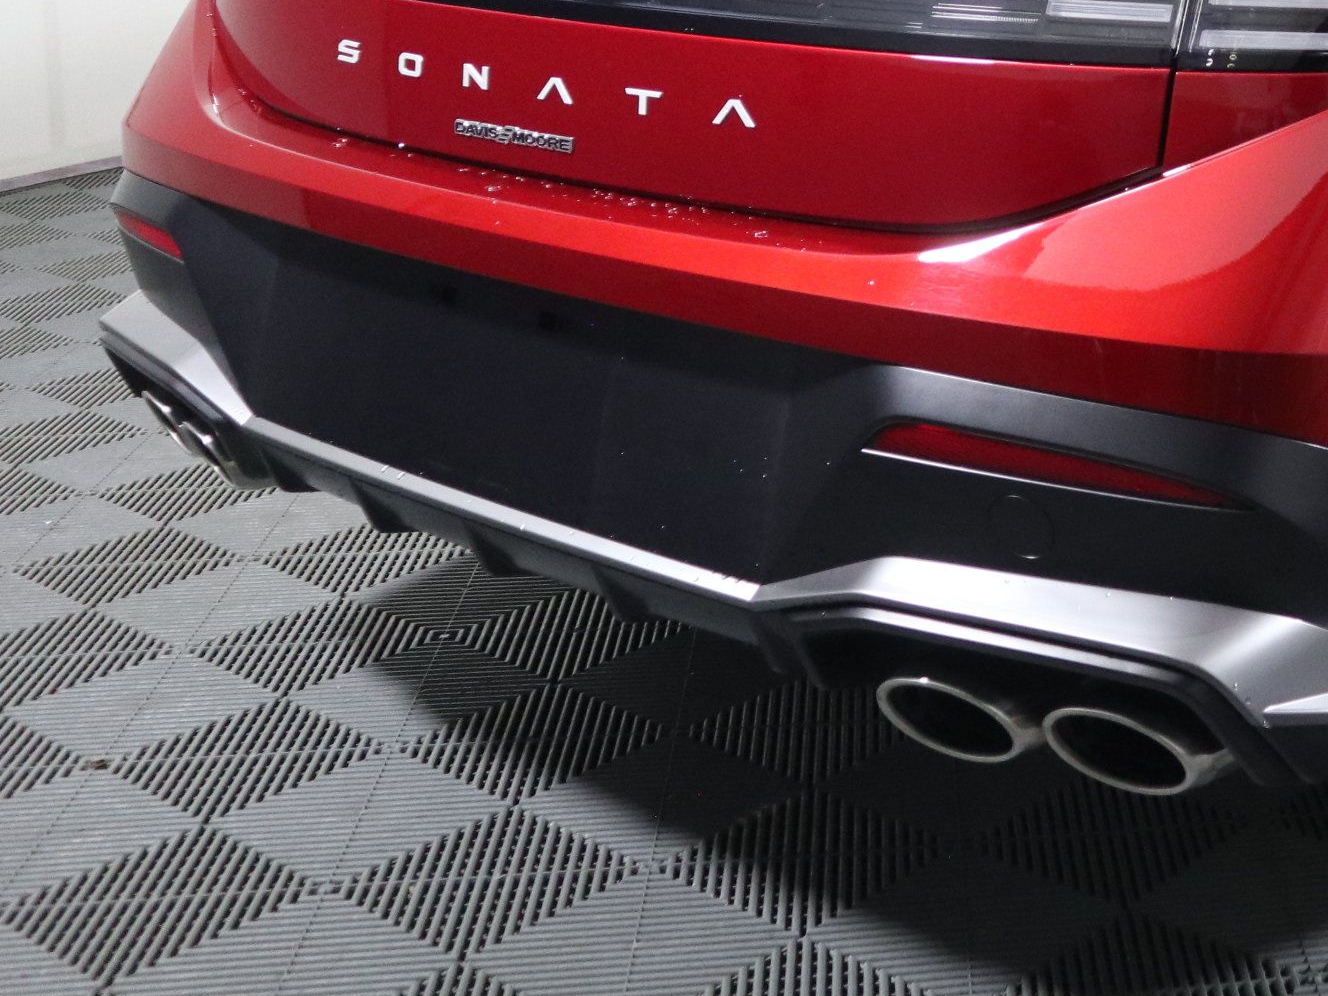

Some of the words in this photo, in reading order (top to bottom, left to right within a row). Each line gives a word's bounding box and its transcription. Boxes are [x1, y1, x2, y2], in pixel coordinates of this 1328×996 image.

[337, 37, 757, 130] SONATA
[455, 120, 499, 140] DAVIS
[511, 131, 571, 152] MOORE
